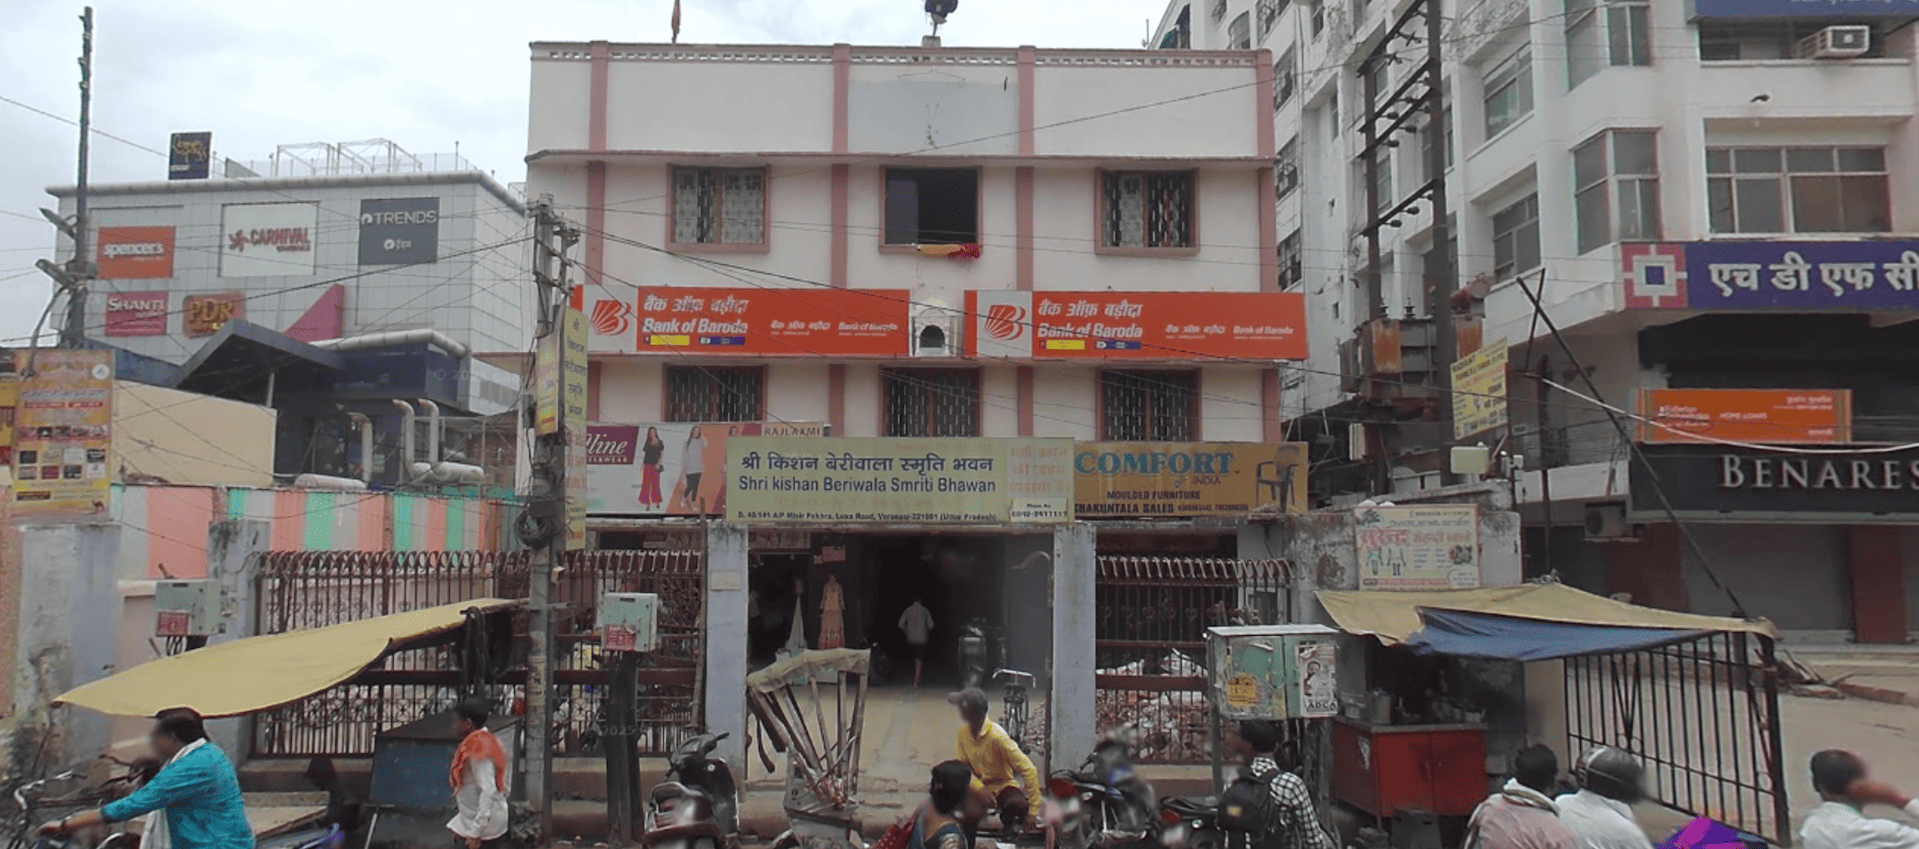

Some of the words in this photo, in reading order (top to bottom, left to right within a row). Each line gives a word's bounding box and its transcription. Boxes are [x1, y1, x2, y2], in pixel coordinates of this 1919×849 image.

[373, 210, 438, 225] TRENDS
[250, 227, 311, 246] CARNIVAL
[1708, 263, 1761, 297] एच
[1768, 251, 1813, 291] डी
[1819, 262, 1875, 297] एफ
[108, 297, 165, 311] SHANTI
[188, 298, 235, 322] PDR
[643, 294, 669, 312] बैंक
[710, 293, 750, 315] बड़ौदा
[1038, 298, 1063, 316] बैंक
[1104, 298, 1144, 320] बड़ौदा
[642, 318, 679, 333] Bank
[681, 318, 697, 333] of
[697, 318, 748, 333] Baroda
[1037, 322, 1075, 338] Bank
[1076, 322, 1092, 338] of
[1092, 322, 1144, 338] Baroda
[1233, 325, 1254, 335] Bank
[1263, 325, 1294, 335] Baroda
[764, 427, 820, 436] RAJLAXMI
[741, 451, 761, 470] श्री
[767, 451, 819, 470] किशन
[825, 452, 894, 471] बेरीवाला
[899, 452, 946, 476] स्मृति
[953, 457, 994, 471] भवन
[1075, 451, 1234, 476] COMFORT
[739, 475, 768, 491] Shri
[772, 475, 819, 491] kishan
[823, 476, 887, 492] Beriwala
[891, 477, 934, 493] Smriti
[938, 477, 996, 493] Bhawan
[1192, 476, 1221, 485] INDIA
[1107, 490, 1149, 501] MOULDED
[1152, 490, 1201, 501] FURNITURE
[1143, 503, 1175, 514] SALES
